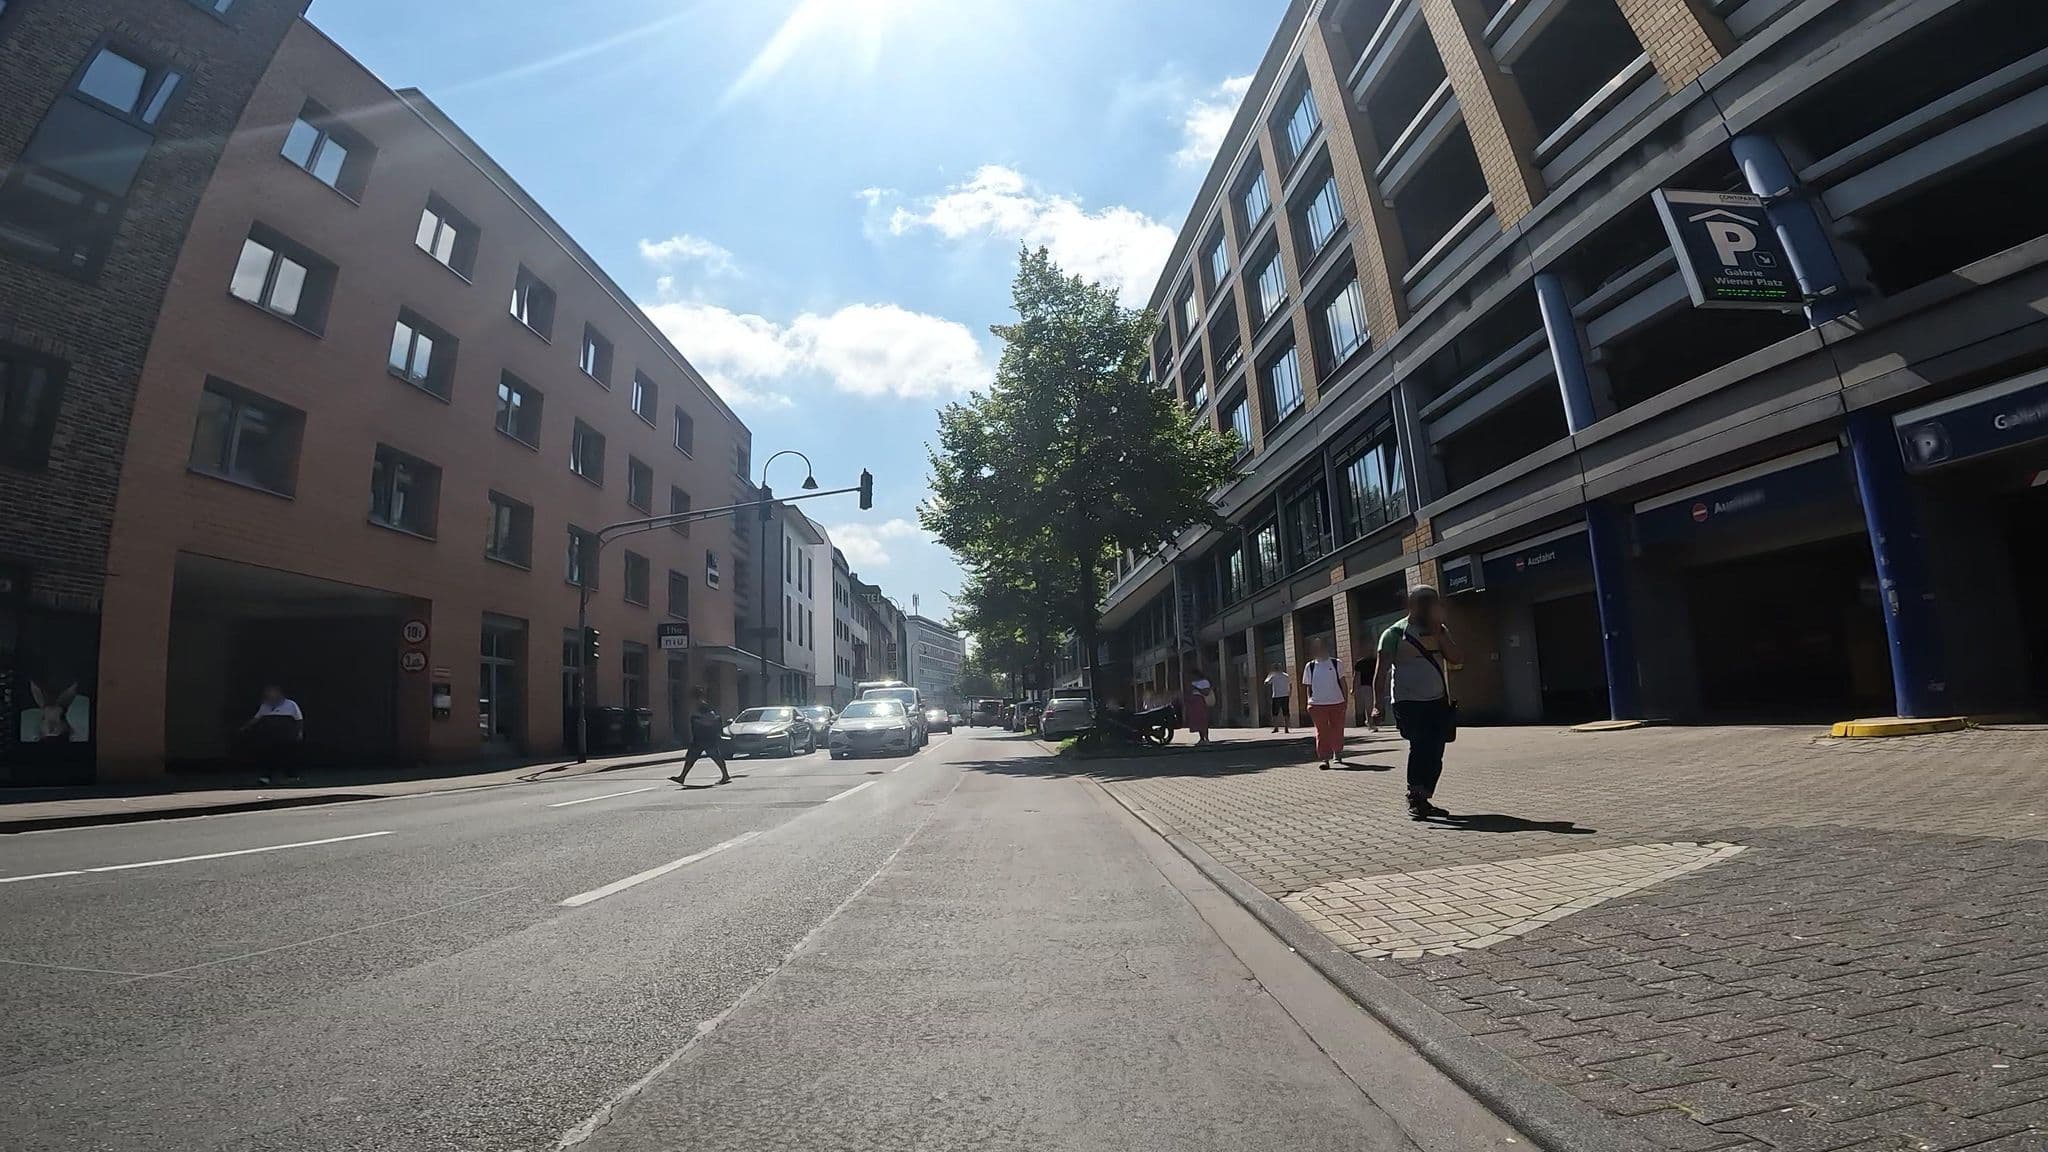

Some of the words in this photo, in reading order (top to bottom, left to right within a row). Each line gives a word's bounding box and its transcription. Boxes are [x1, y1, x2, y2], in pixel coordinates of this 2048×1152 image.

[1705, 221, 1757, 266] P
[1724, 268, 1764, 277] Galerie
[1713, 277, 1754, 287] Wiener
[1756, 278, 1784, 287] Platz
[1527, 551, 1556, 566] Ausfahrt
